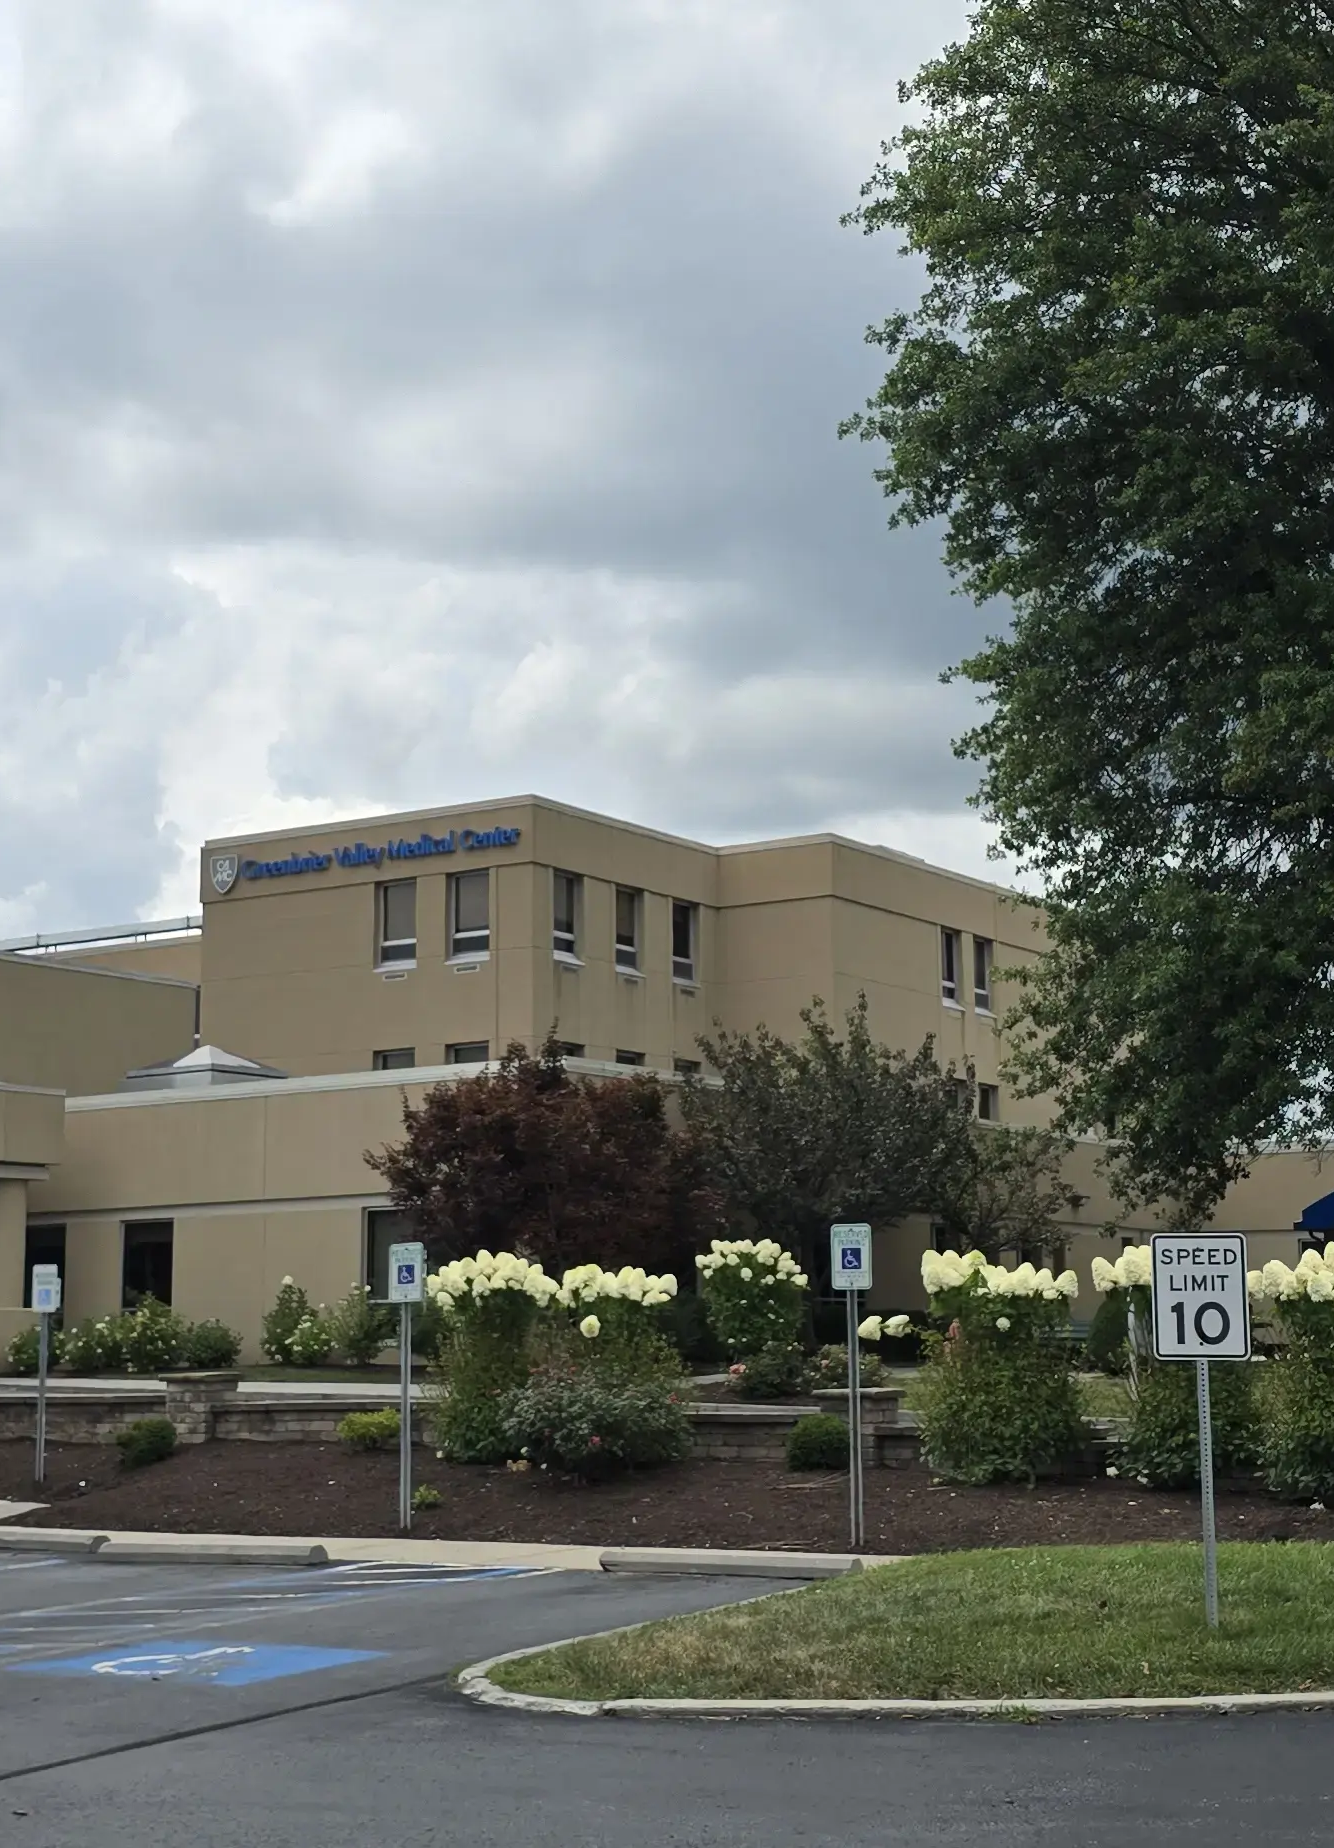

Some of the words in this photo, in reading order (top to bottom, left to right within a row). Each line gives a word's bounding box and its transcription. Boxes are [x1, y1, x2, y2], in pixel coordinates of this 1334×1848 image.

[242, 851, 332, 879] Greenbrier
[332, 842, 386, 870] Valley
[387, 829, 457, 859] Medical
[459, 826, 521, 851] Center
[1160, 1248, 1237, 1265] SPEED
[1169, 1274, 1229, 1292] LIMIT
[1170, 1301, 1230, 1346] 10
